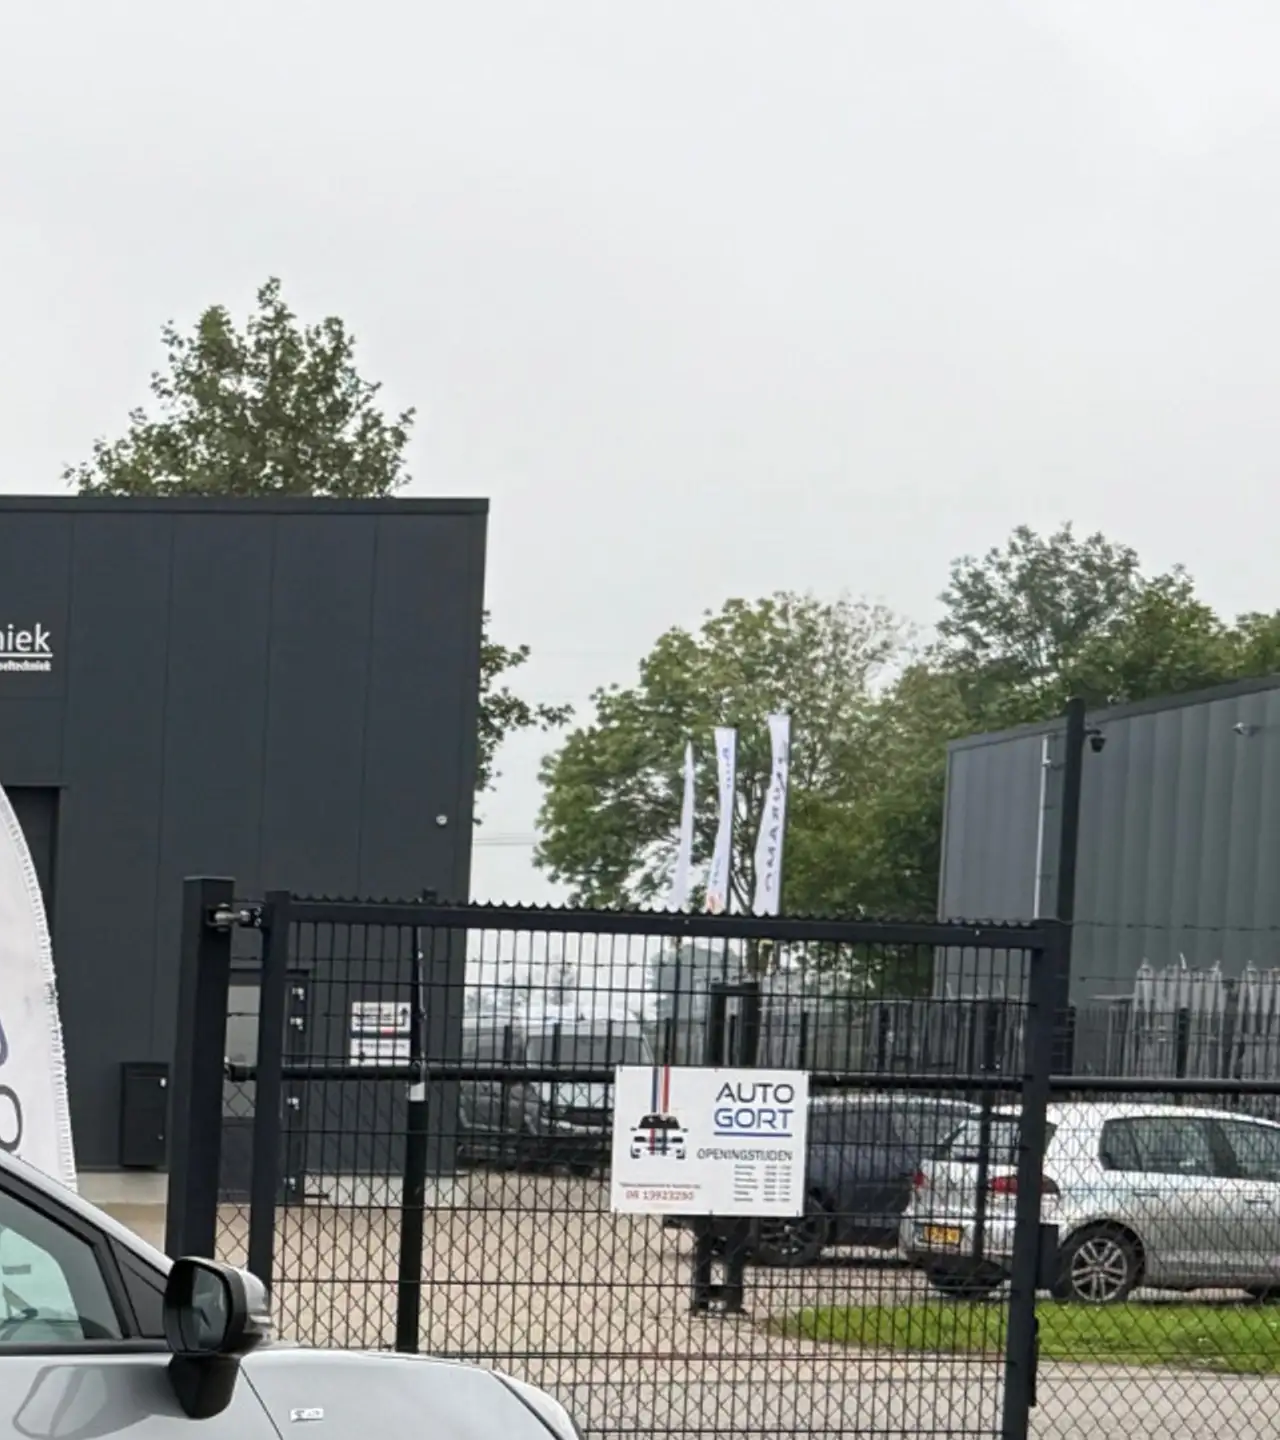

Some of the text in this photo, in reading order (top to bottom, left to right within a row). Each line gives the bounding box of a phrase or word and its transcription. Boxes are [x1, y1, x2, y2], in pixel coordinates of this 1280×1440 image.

[715, 1082, 795, 1104] AUTO
[714, 1107, 794, 1130] GORT
[697, 1147, 793, 1162] OPENINGSTIJDEN
